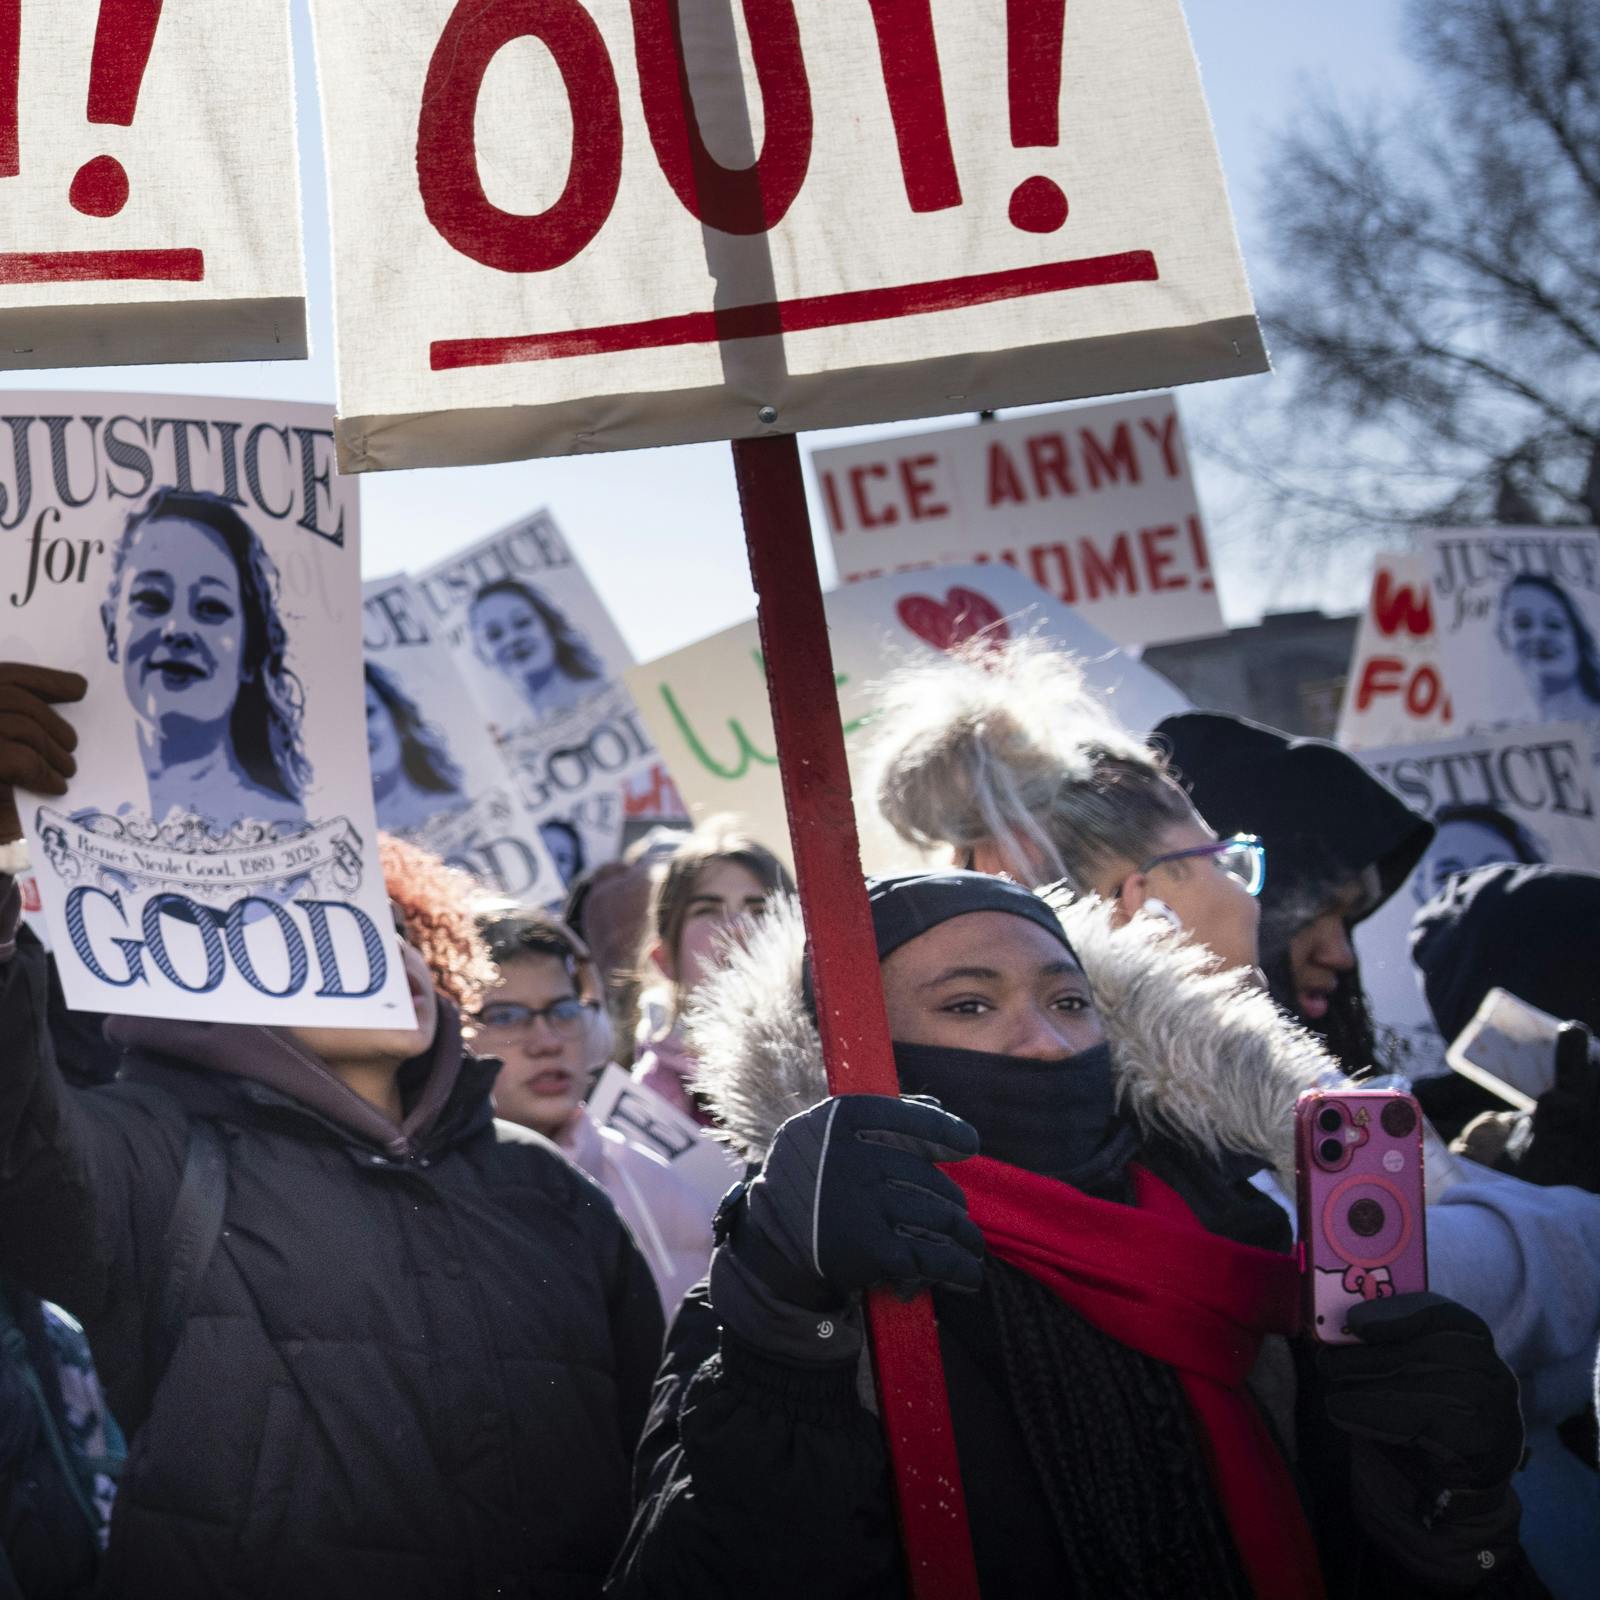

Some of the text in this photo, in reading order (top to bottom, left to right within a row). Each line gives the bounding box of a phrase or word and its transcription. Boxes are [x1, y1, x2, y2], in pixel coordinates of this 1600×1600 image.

[822, 408, 1184, 533] ICE ARMY
[10, 507, 105, 608] for
[416, 521, 571, 617] USTICE
[974, 517, 1217, 606] OME!
[1376, 740, 1595, 820] STICE
[132, 850, 184, 876] Nicole
[65, 885, 388, 998] GOOD
